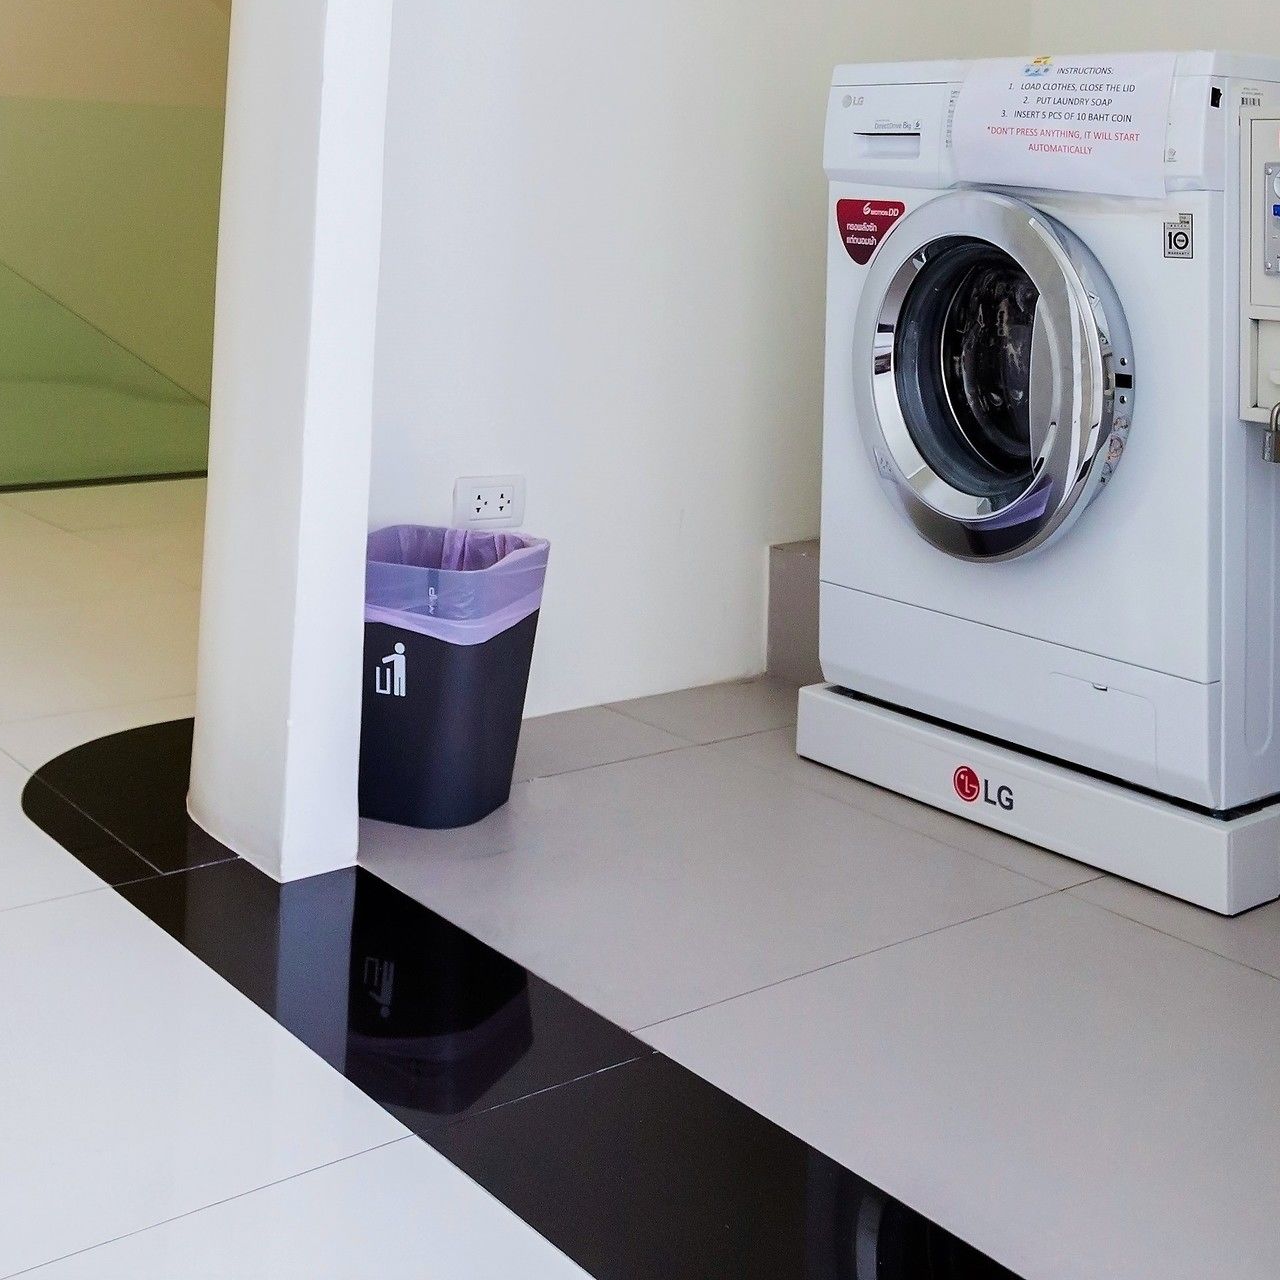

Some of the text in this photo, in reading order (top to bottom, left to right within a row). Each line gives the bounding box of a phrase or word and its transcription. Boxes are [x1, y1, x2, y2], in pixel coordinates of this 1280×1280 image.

[1042, 83, 1077, 92] CLOTHES,
[1106, 84, 1121, 92] THE
[853, 97, 864, 106] LG
[1091, 98, 1113, 106] SOAP
[1014, 110, 1040, 119] INSERT
[1064, 112, 1075, 120] OF
[1088, 113, 1110, 121] BAHT
[1111, 114, 1132, 122] COIN
[1016, 128, 1038, 136] PRESS
[1040, 129, 1082, 139] ANYTHING,
[1084, 131, 1091, 139] IT
[1093, 132, 1112, 140] WILL
[1115, 132, 1140, 141] START
[1029, 143, 1092, 154] AUTOMATICALLY
[1168, 231, 1189, 250] 10
[984, 779, 1014, 810] LG
